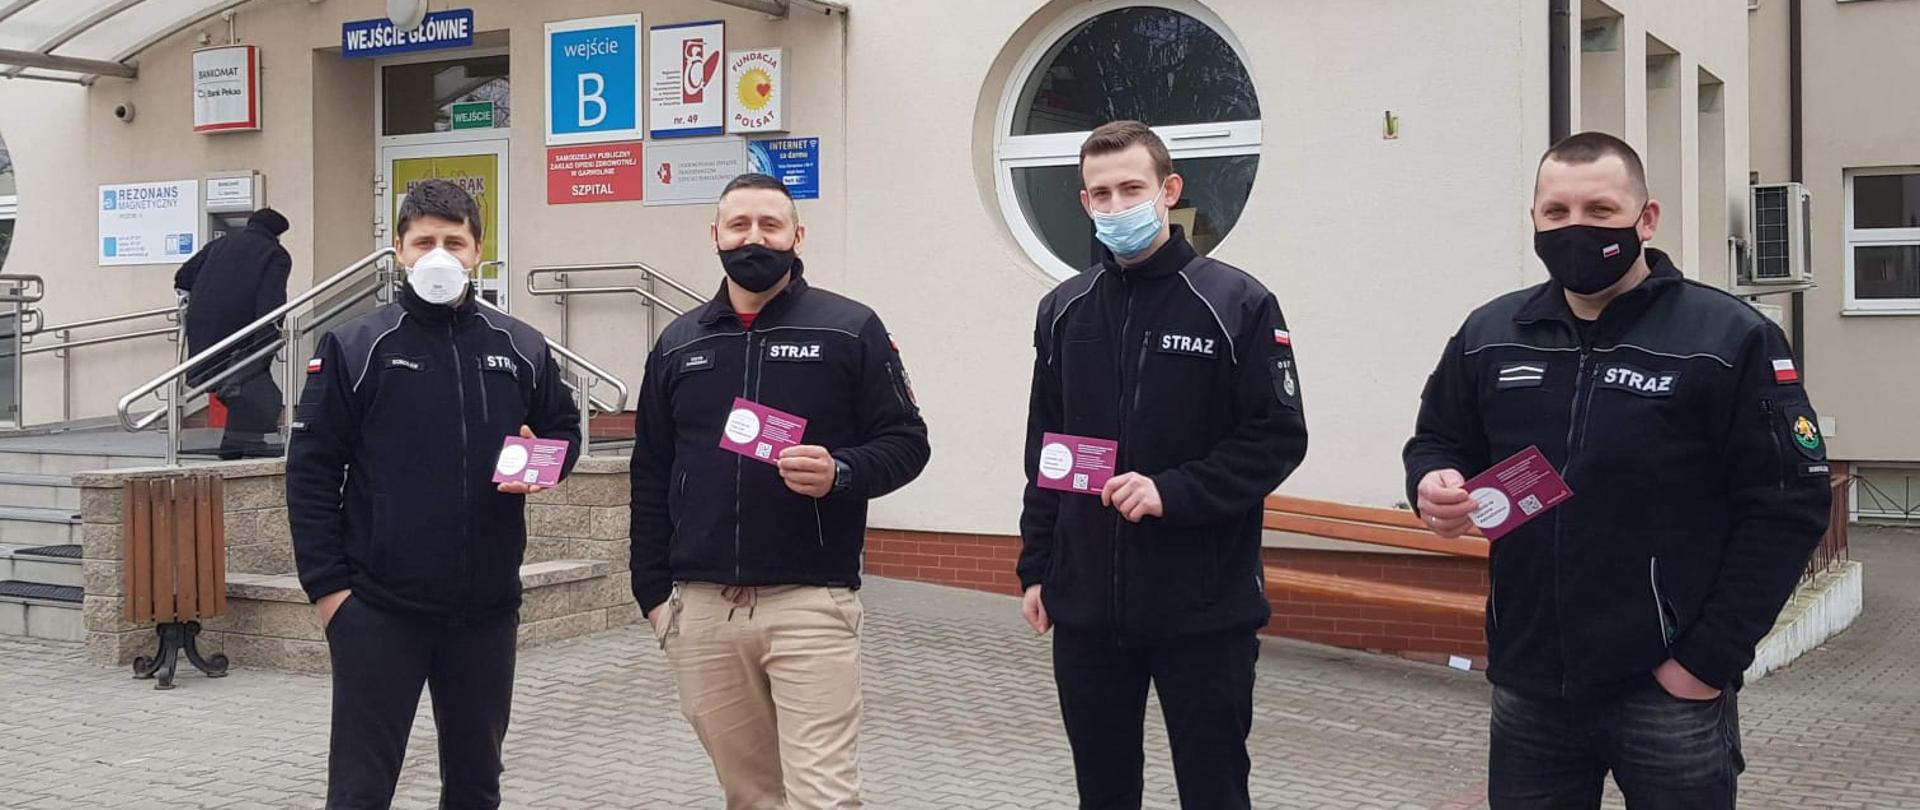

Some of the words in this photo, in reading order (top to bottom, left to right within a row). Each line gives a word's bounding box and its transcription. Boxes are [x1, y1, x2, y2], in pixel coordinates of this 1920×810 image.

[347, 23, 406, 50] WEJŚCIE
[408, 17, 468, 43] GŁÓWNE
[564, 37, 619, 61] wejście
[732, 52, 777, 73] FUNDACJA
[577, 72, 607, 127] B
[454, 110, 491, 122] WEJŚCIE
[687, 115, 699, 124] 49
[734, 110, 775, 128] POLSAT
[769, 141, 807, 150] INTERNET
[119, 186, 178, 200] REZONANS
[571, 184, 615, 196] SZPITAL
[118, 198, 178, 210] MAGNETYCZNY
